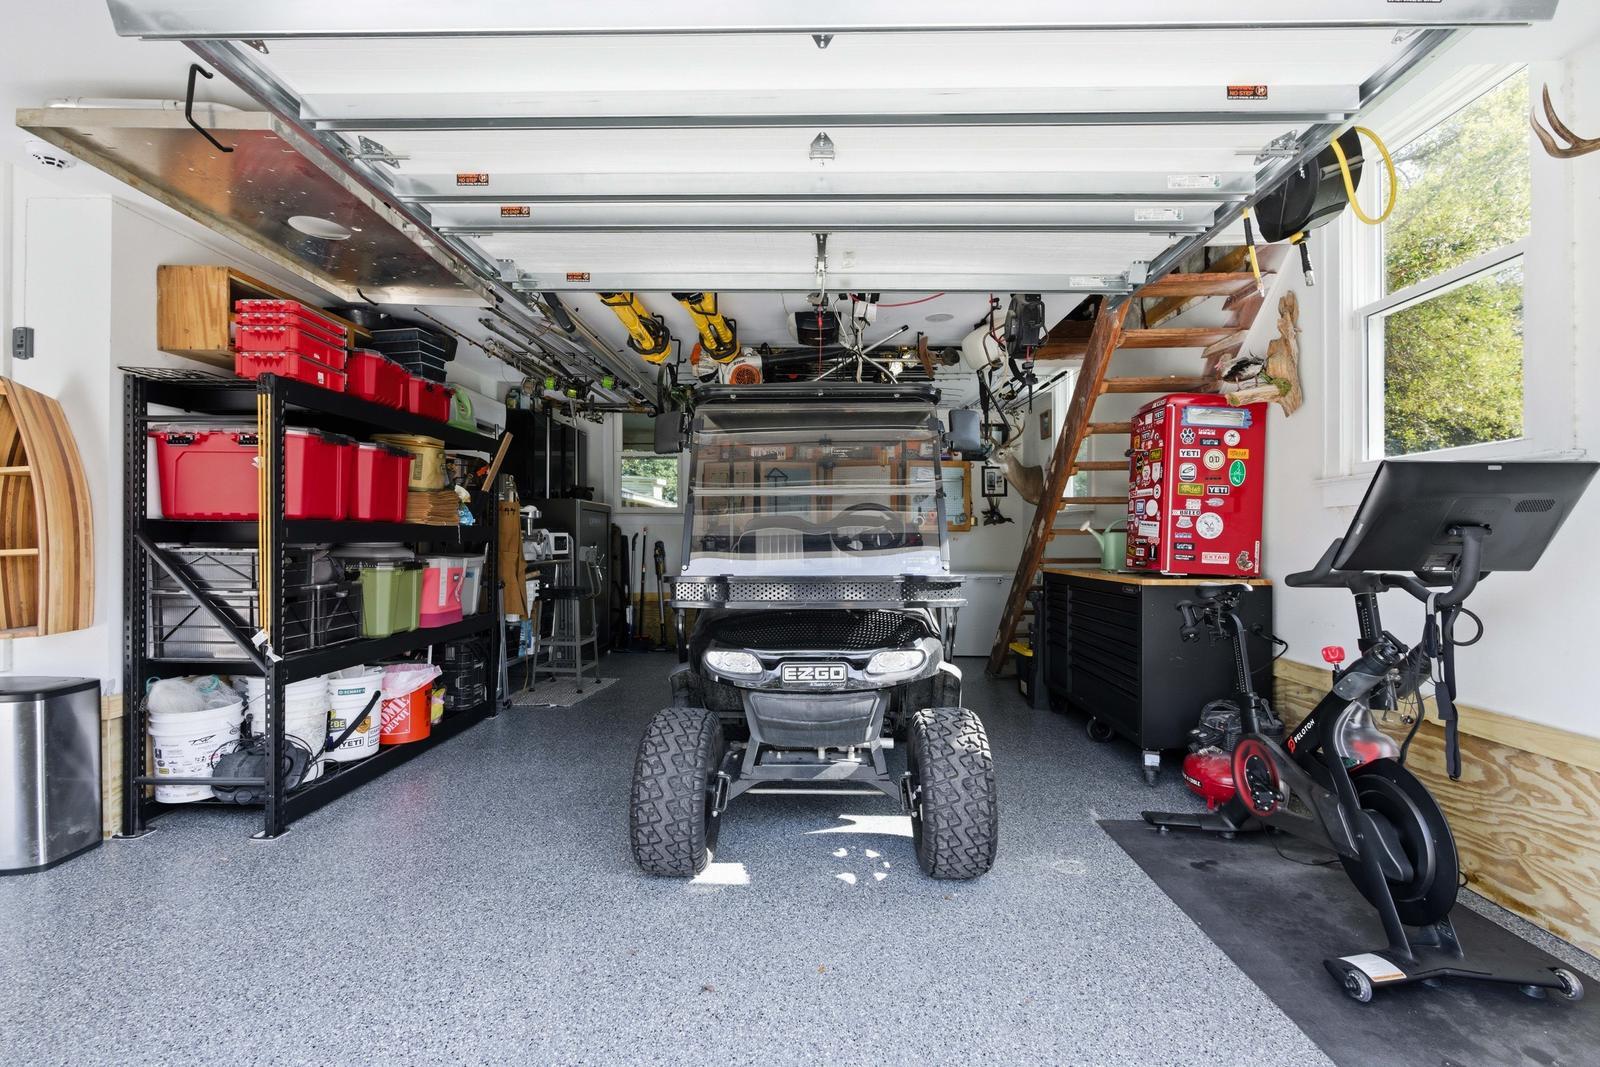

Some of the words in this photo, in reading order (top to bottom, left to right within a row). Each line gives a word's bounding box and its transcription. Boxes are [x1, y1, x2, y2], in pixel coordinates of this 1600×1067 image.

[784, 667, 844, 680] EZGO
[381, 696, 410, 725] OME
[384, 708, 410, 734] DEPOT
[342, 739, 362, 747] YETI
[1294, 718, 1315, 743] PELOTON
